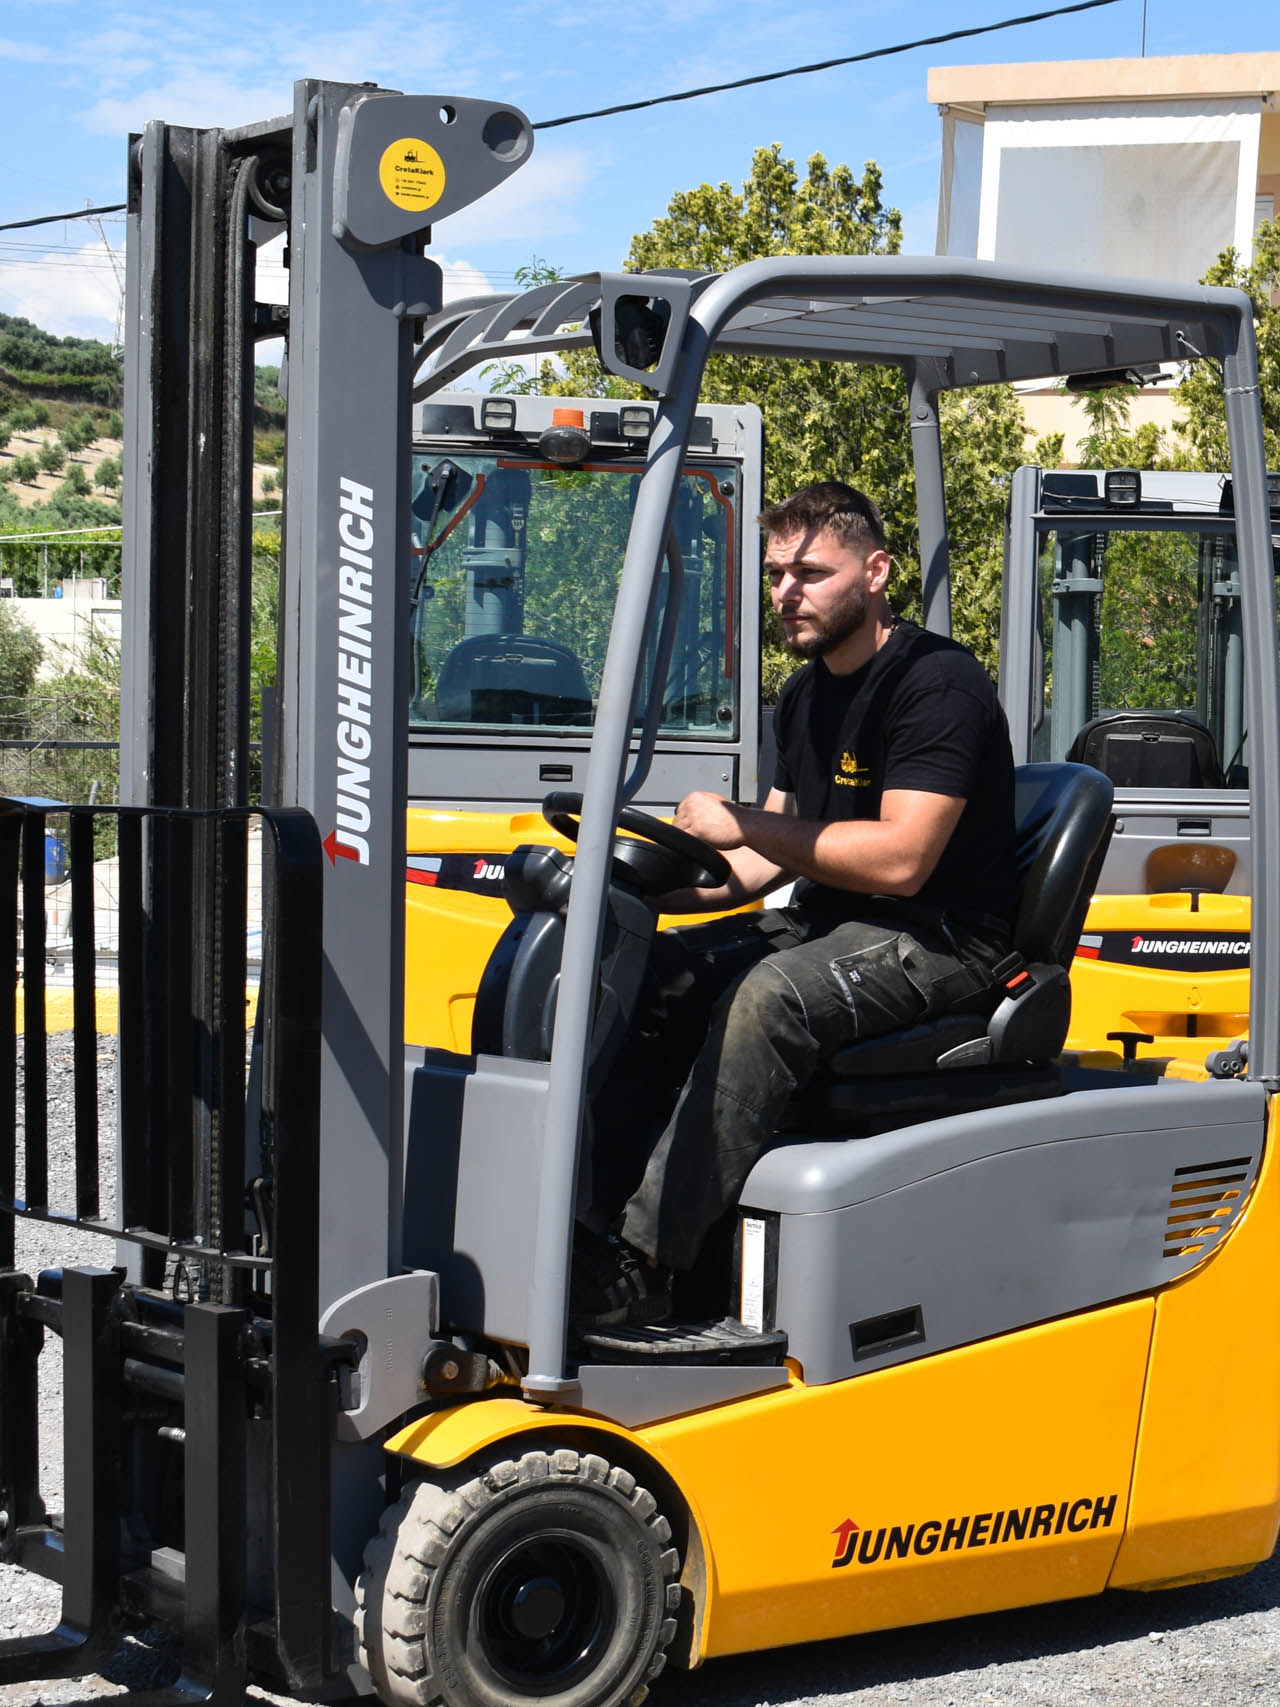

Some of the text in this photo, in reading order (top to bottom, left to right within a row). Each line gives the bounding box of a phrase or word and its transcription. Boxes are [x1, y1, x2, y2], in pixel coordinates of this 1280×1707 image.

[394, 165, 434, 176] CretaKlark
[336, 476, 374, 867] JUNGHEINRICH
[831, 1494, 1118, 1568] JUNGHEINRICH
